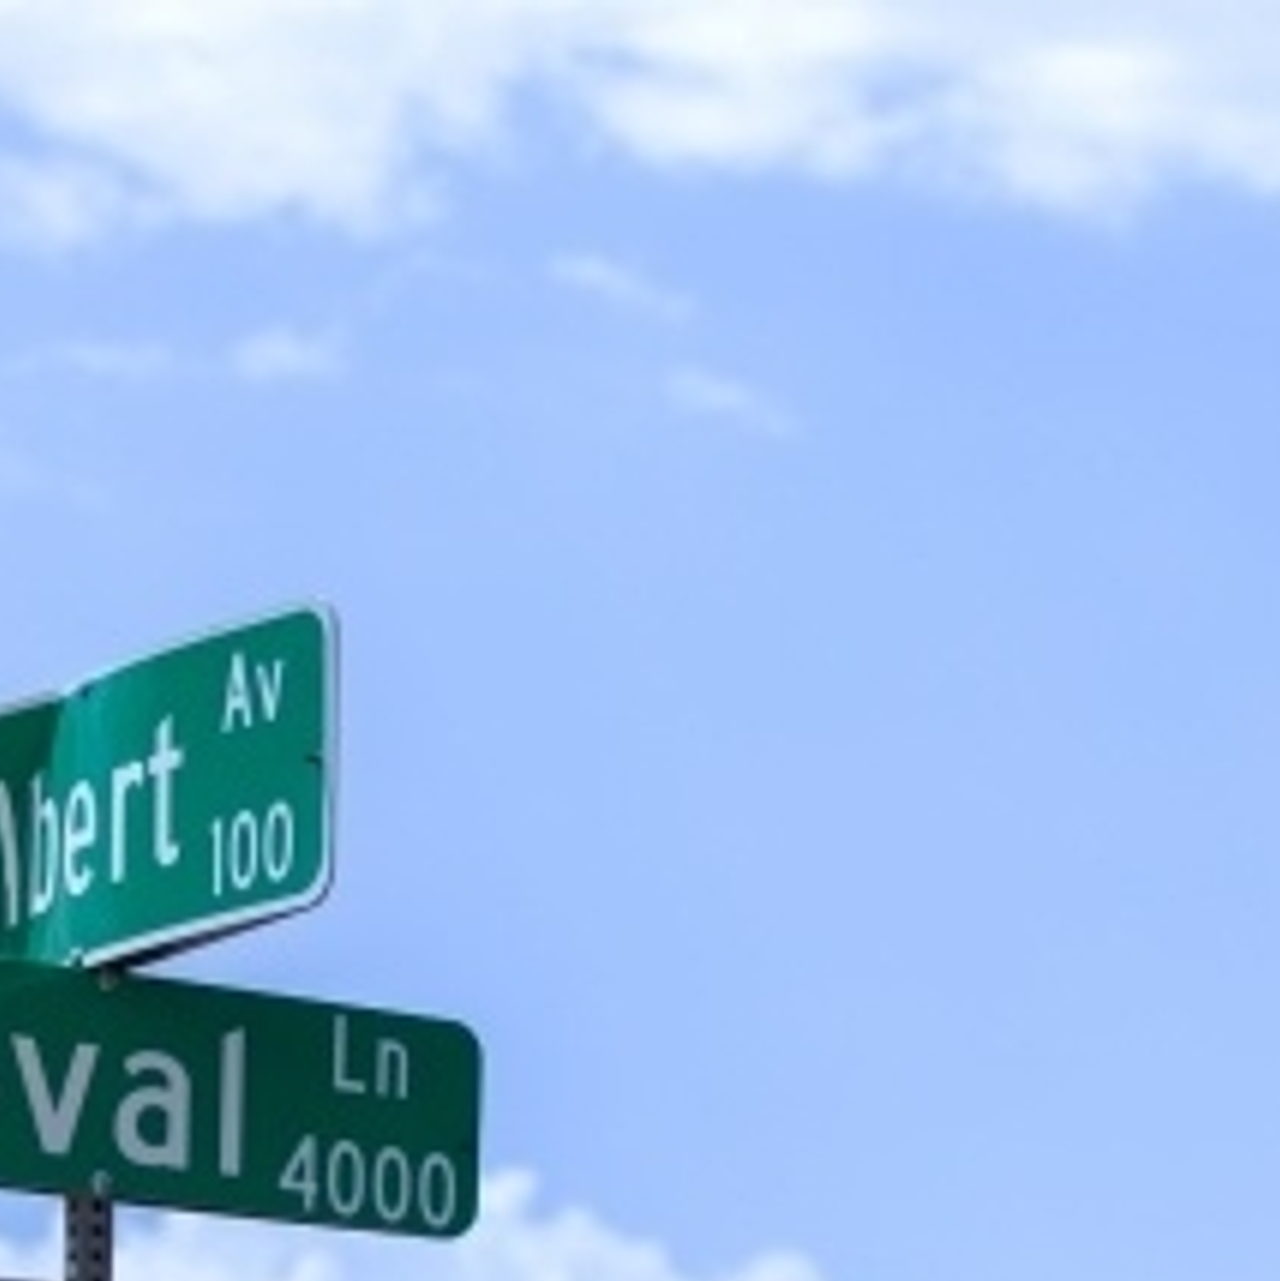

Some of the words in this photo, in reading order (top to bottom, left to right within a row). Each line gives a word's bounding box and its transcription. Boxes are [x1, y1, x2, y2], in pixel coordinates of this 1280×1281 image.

[220, 650, 286, 734] Av
[210, 800, 296, 898] 100
[332, 1013, 410, 1101] Ln
[277, 1132, 458, 1228] 4000
